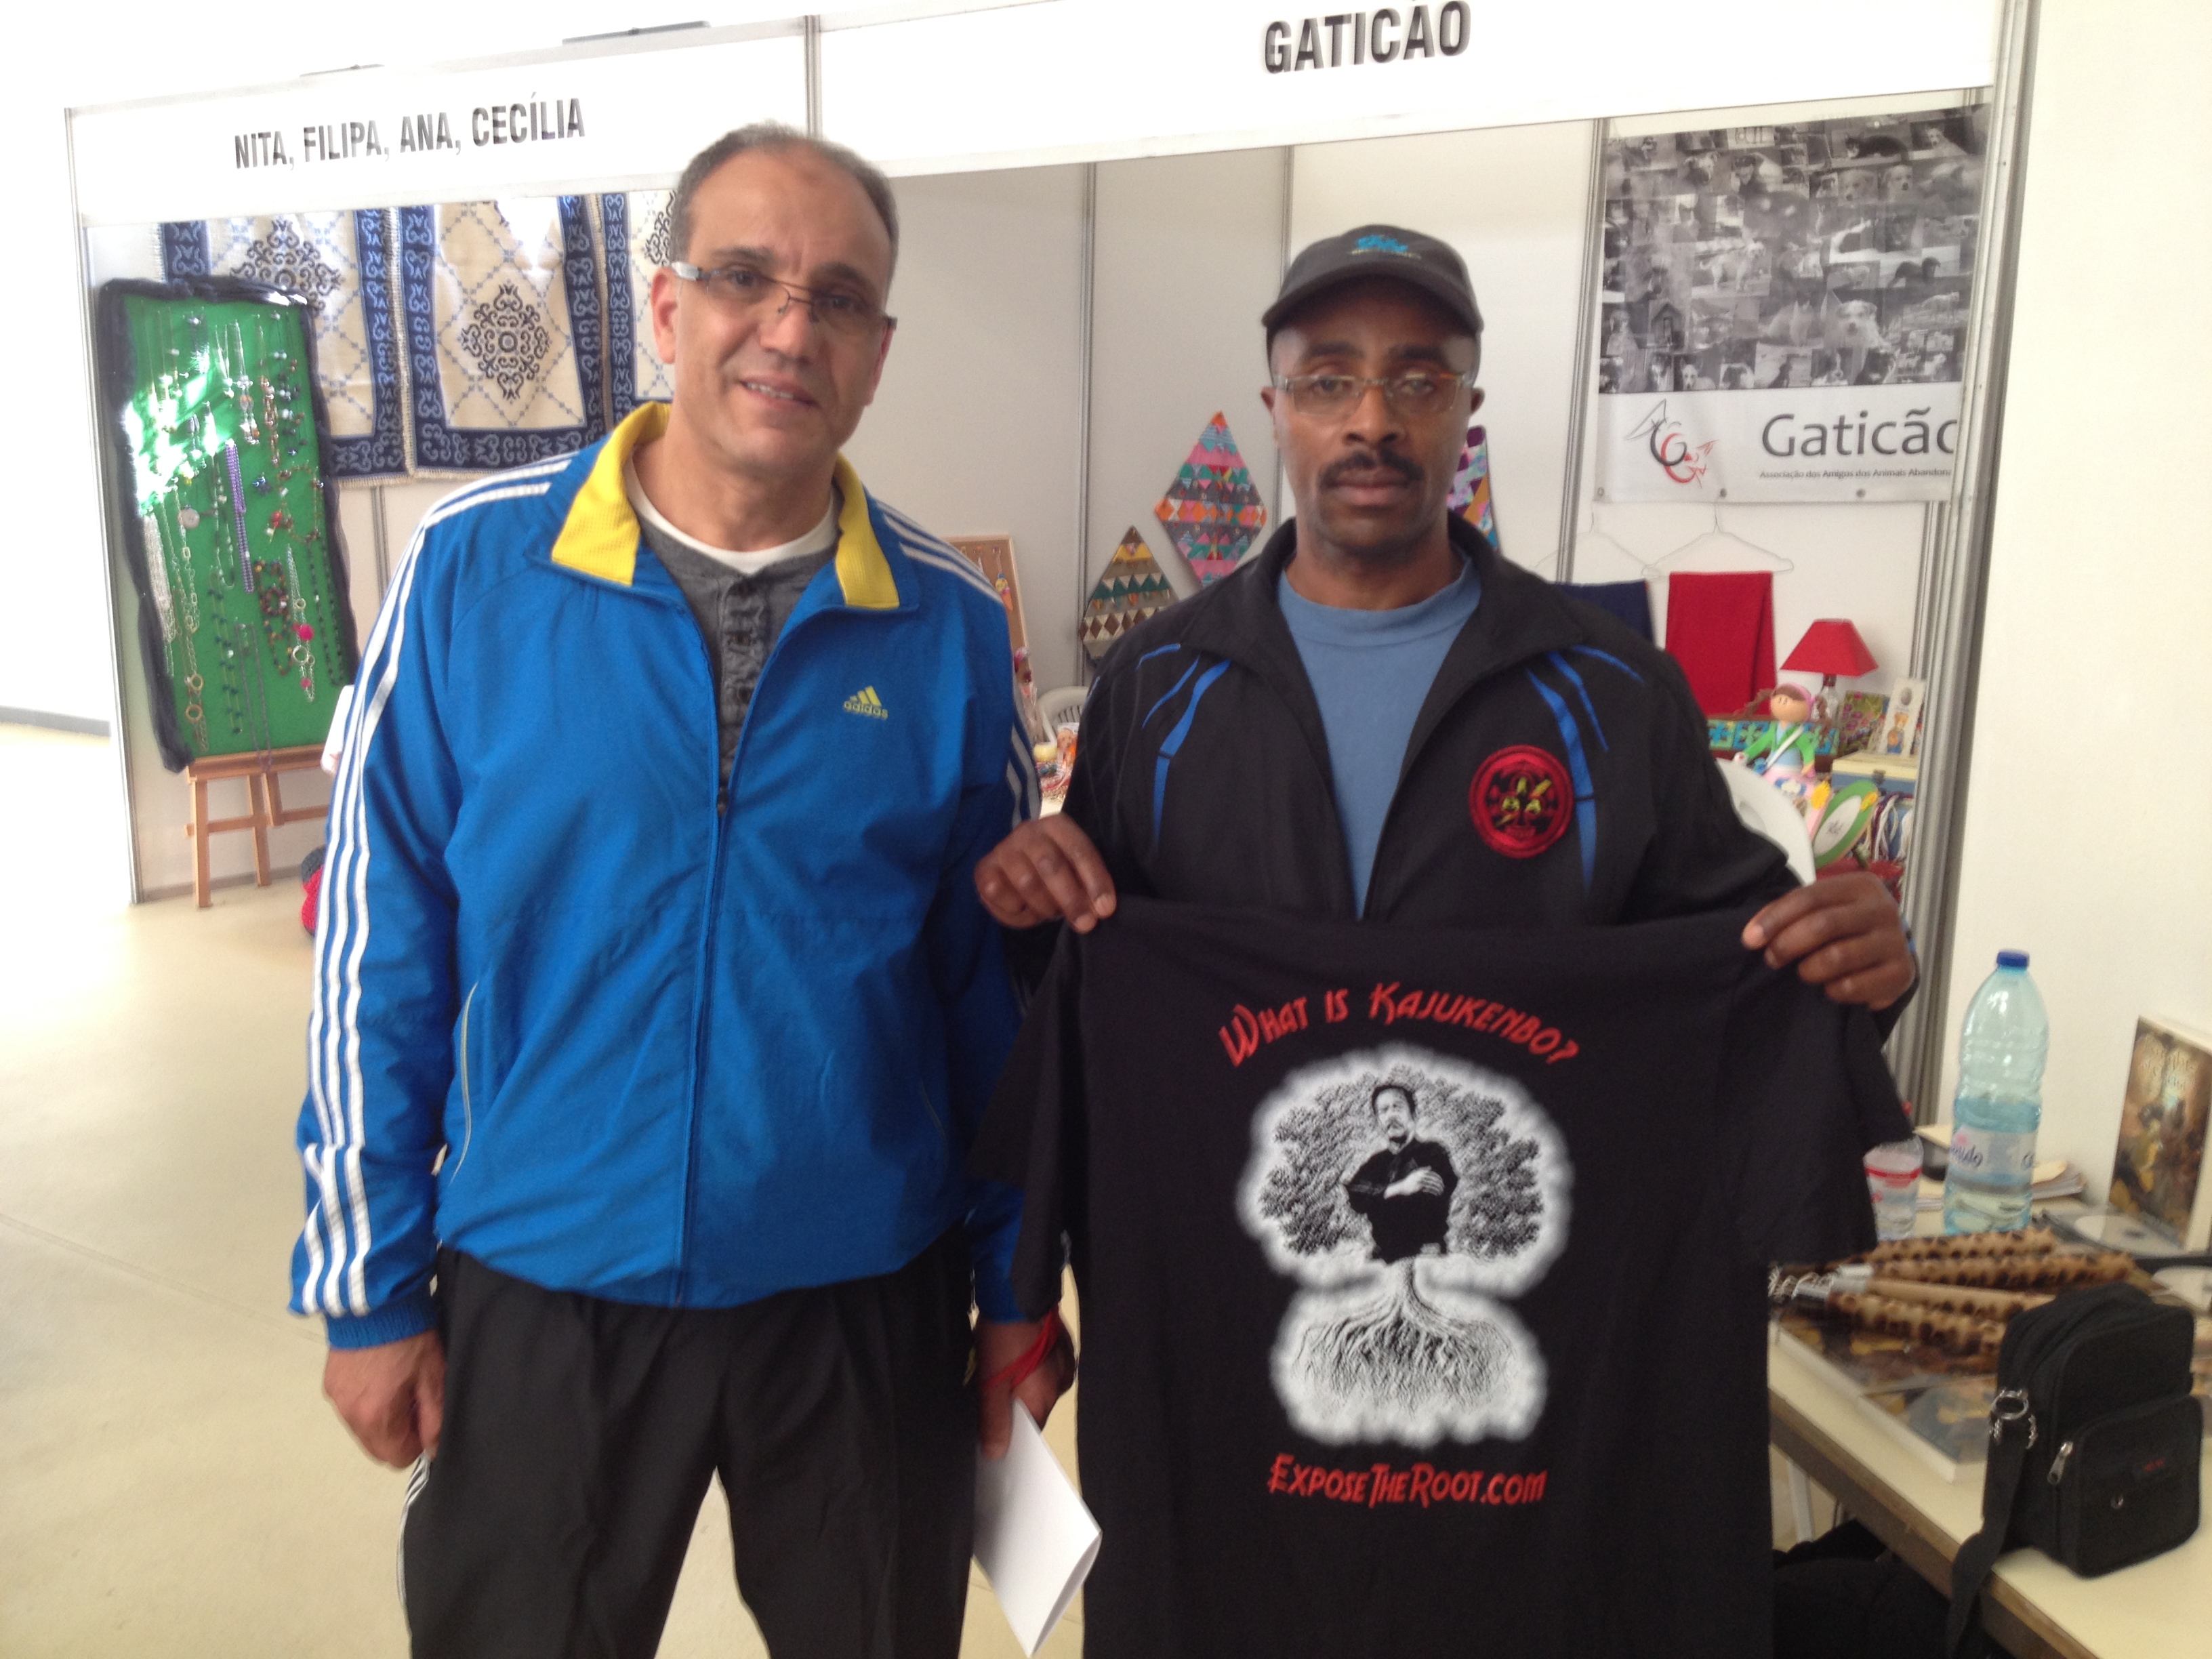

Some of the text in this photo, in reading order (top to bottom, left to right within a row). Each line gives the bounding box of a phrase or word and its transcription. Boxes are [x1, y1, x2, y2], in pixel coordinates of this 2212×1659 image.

[1265, 1, 1471, 74] GATICAO
[234, 91, 586, 171] NITA, FILIPA, ANA, CECÍLIA
[1805, 470, 1820, 478] dos
[1822, 469, 1853, 480] Amigos
[1856, 468, 1870, 477] dos
[1872, 468, 1906, 476] Animais
[844, 701, 888, 720] adidas
